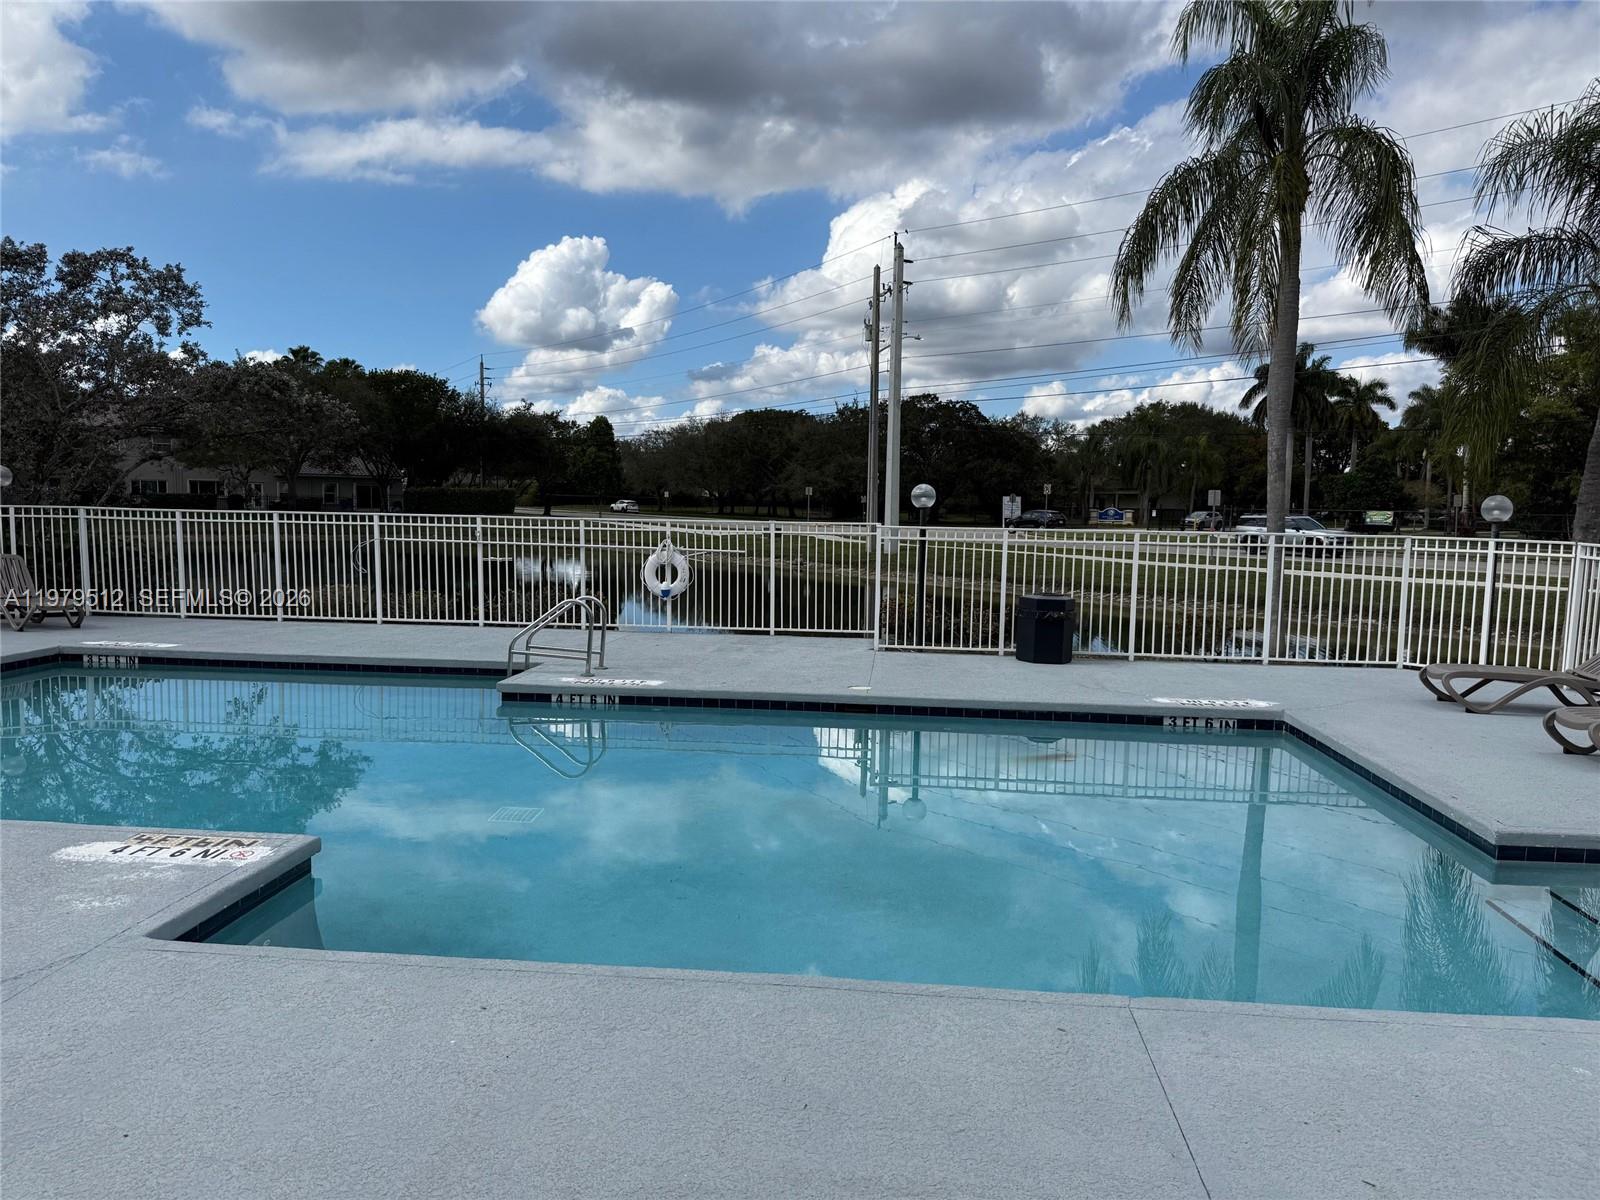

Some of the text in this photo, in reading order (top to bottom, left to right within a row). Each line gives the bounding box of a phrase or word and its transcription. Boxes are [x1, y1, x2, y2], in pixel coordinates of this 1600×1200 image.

[570, 694, 584, 703] FT
[590, 695, 597, 704] 6
[604, 695, 616, 704] IN
[1168, 716, 1236, 728] 3 FT 6 IN
[151, 836, 200, 847] FT
[109, 845, 131, 855] 4
[129, 846, 170, 856] FT
[170, 848, 192, 857] 6
